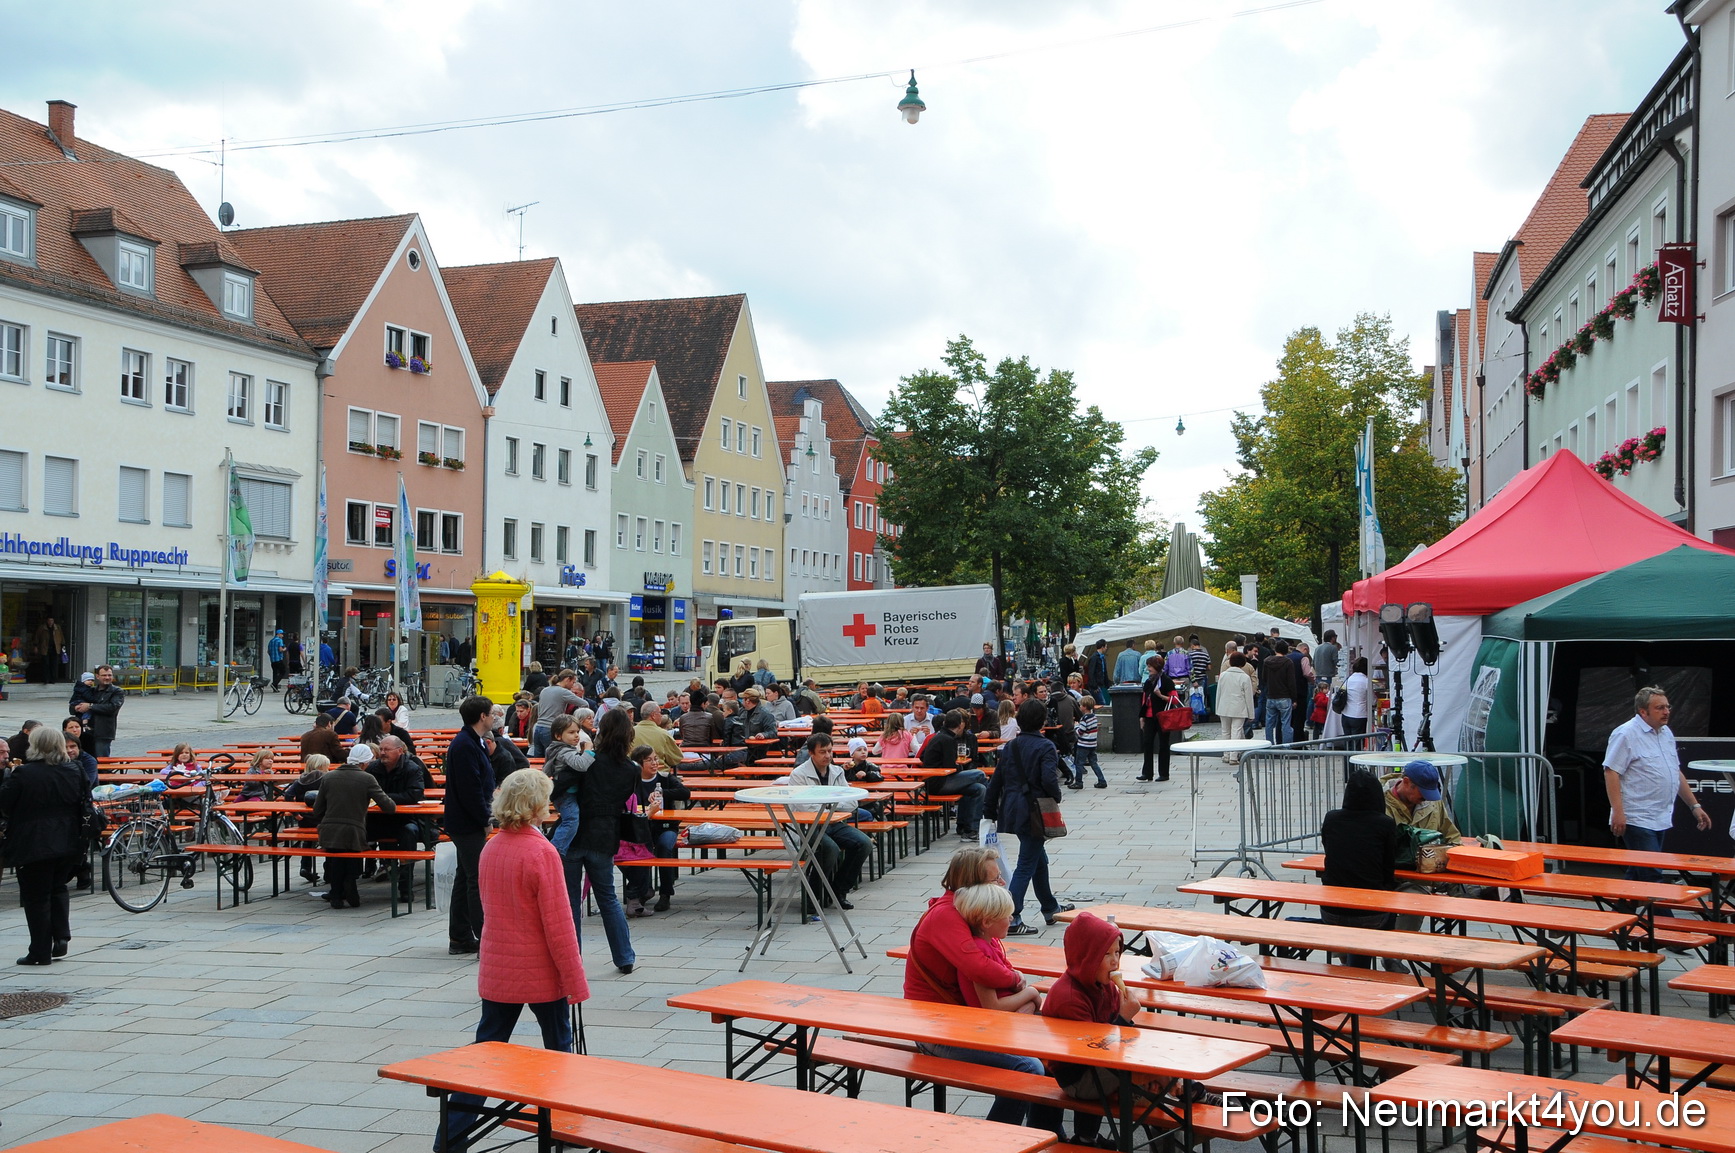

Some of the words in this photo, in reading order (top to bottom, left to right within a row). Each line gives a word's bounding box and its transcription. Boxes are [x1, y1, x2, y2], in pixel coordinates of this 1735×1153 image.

[1664, 261, 1686, 317] Achatz
[107, 542, 188, 567] Rupprecht
[560, 564, 586, 586] fries
[883, 610, 957, 624] Bayerisches
[884, 624, 919, 634] Rotes
[884, 636, 919, 646] Kreuz
